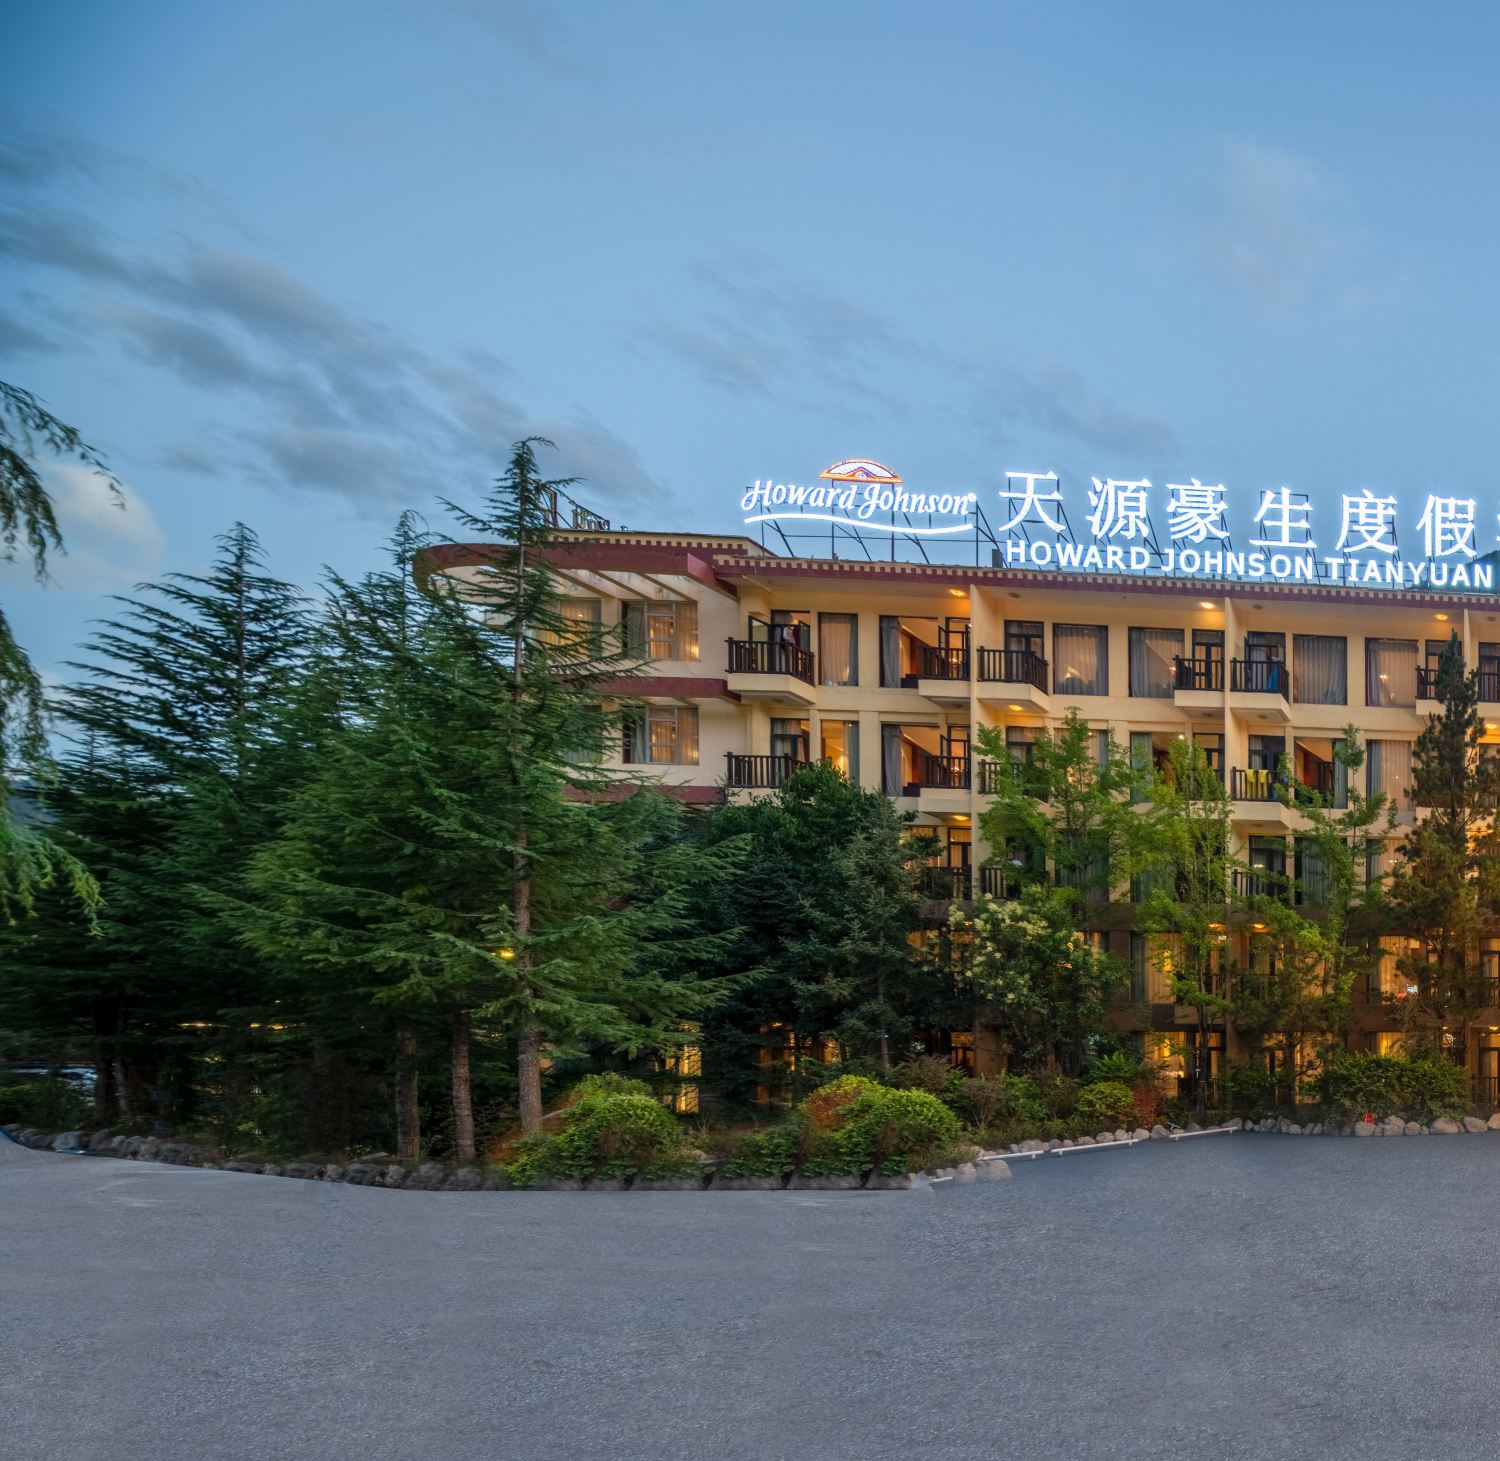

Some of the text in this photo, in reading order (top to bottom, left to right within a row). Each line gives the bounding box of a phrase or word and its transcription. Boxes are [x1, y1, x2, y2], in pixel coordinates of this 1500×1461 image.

[741, 479, 856, 512] Howard
[1006, 539, 1151, 570] HOWARD
[1160, 550, 1315, 581] JOHNSON
[1324, 557, 1494, 588] TIANYUAN
